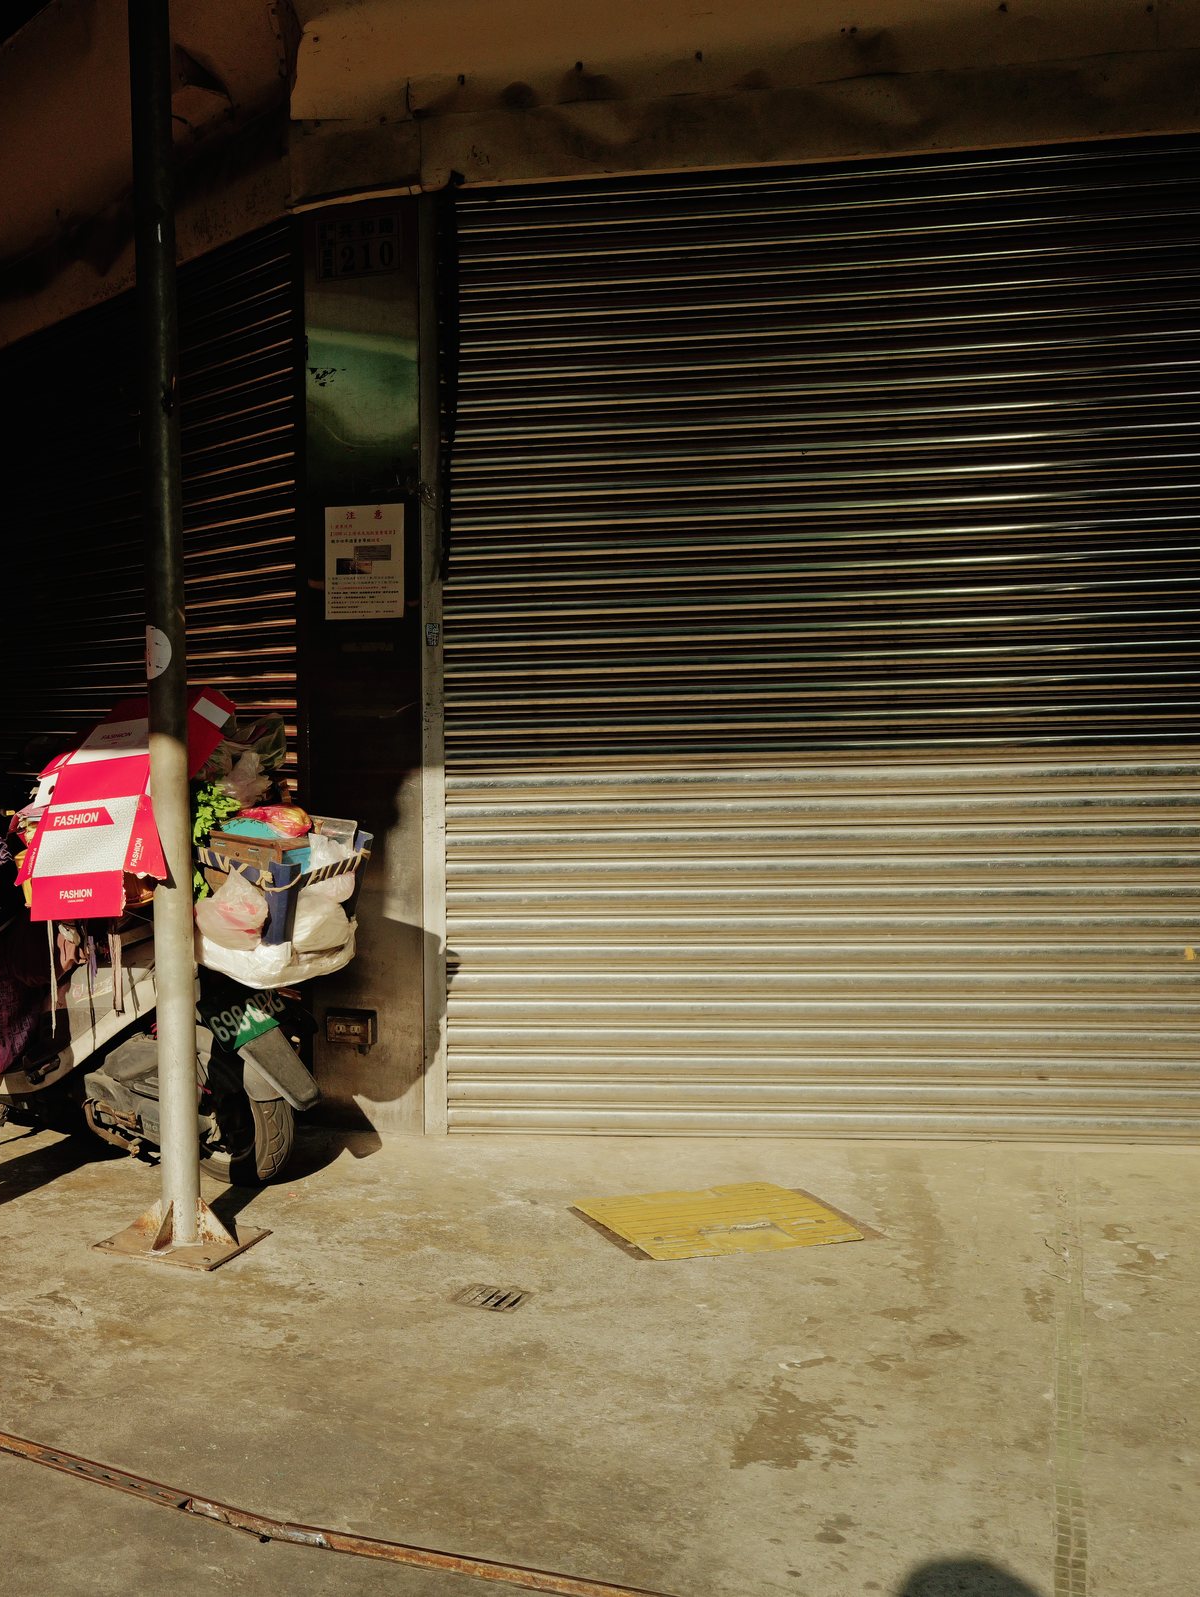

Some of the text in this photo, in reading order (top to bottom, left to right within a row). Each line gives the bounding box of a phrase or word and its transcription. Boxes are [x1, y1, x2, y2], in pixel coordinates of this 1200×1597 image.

[341, 241, 393, 272] 210
[53, 811, 99, 827] FASHION
[130, 837, 143, 867] FASHION
[59, 888, 93, 900] FASHION
